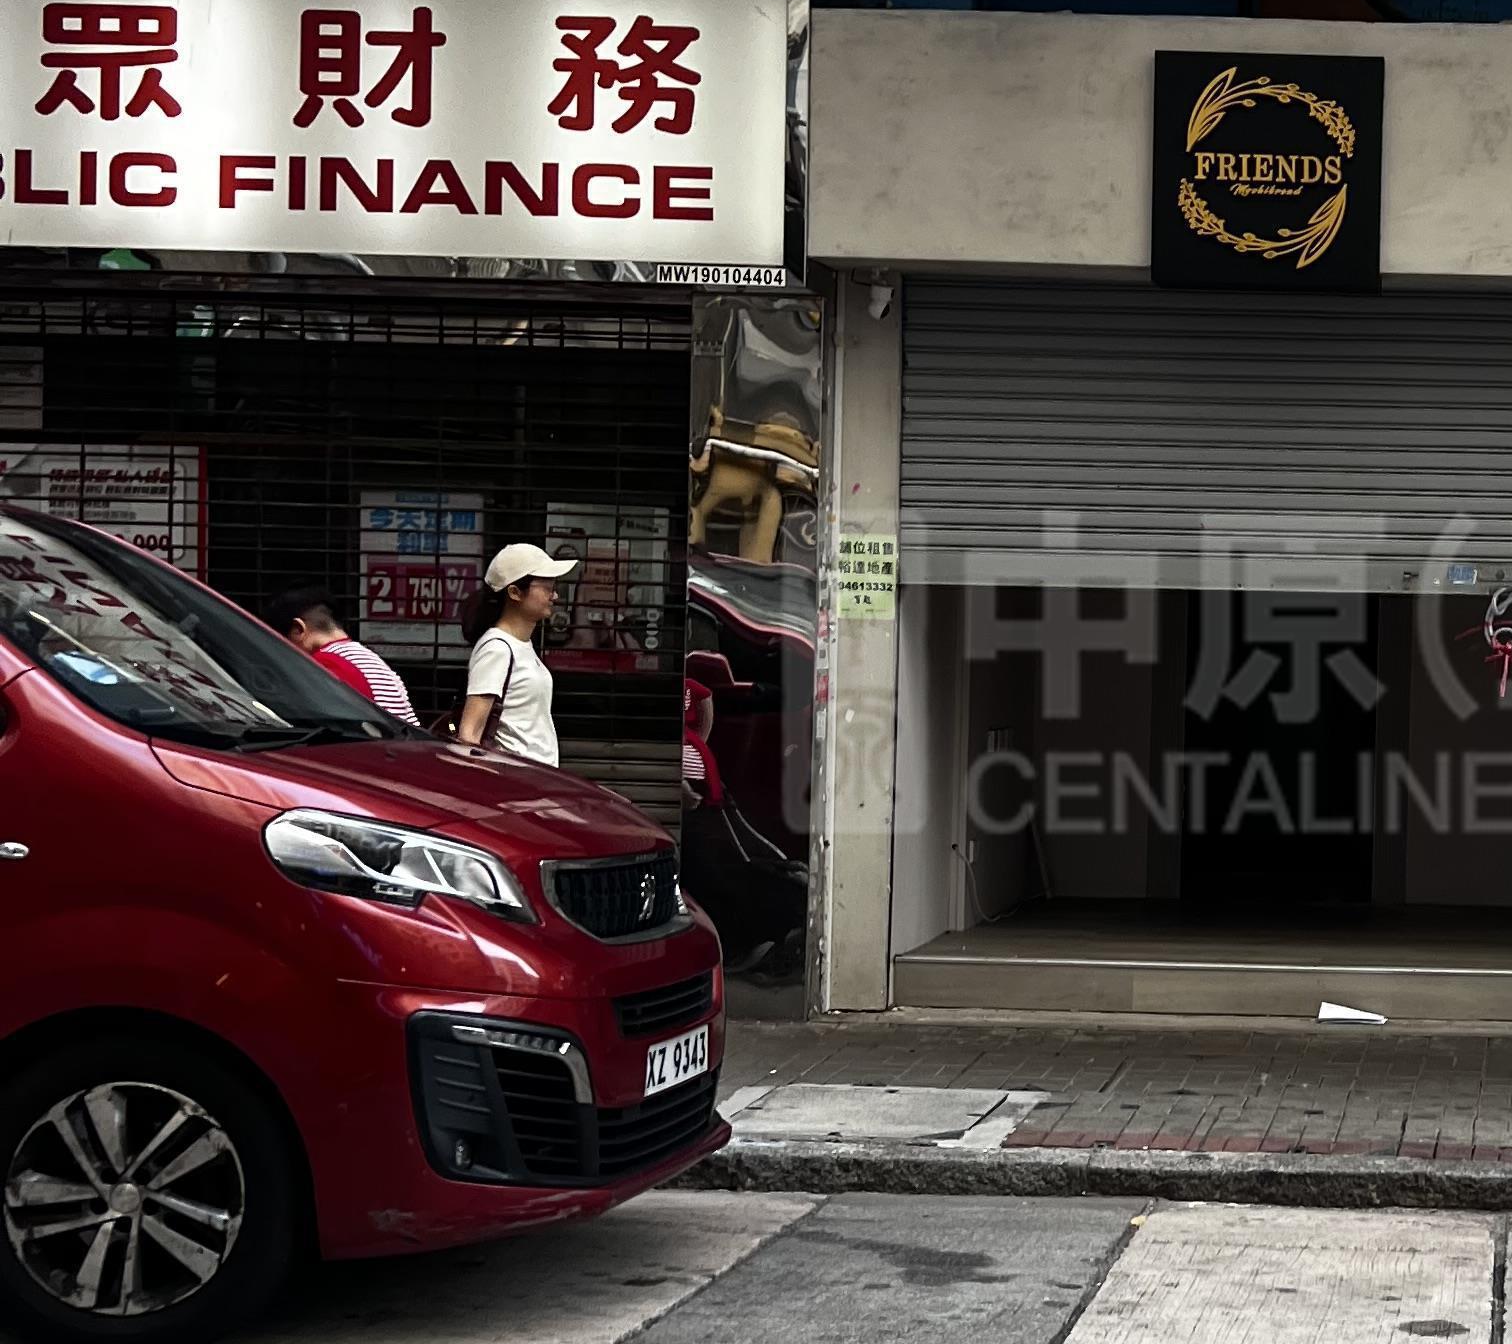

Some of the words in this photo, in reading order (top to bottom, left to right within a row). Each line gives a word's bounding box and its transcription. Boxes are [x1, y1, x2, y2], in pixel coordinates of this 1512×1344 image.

[0, 149, 178, 207] LIC
[217, 155, 715, 222] FINANCE
[1194, 152, 1343, 185] FRIENDS
[658, 265, 784, 285] MW190104404
[646, 1046, 668, 1089] XZ
[673, 1031, 706, 1079] 9343
